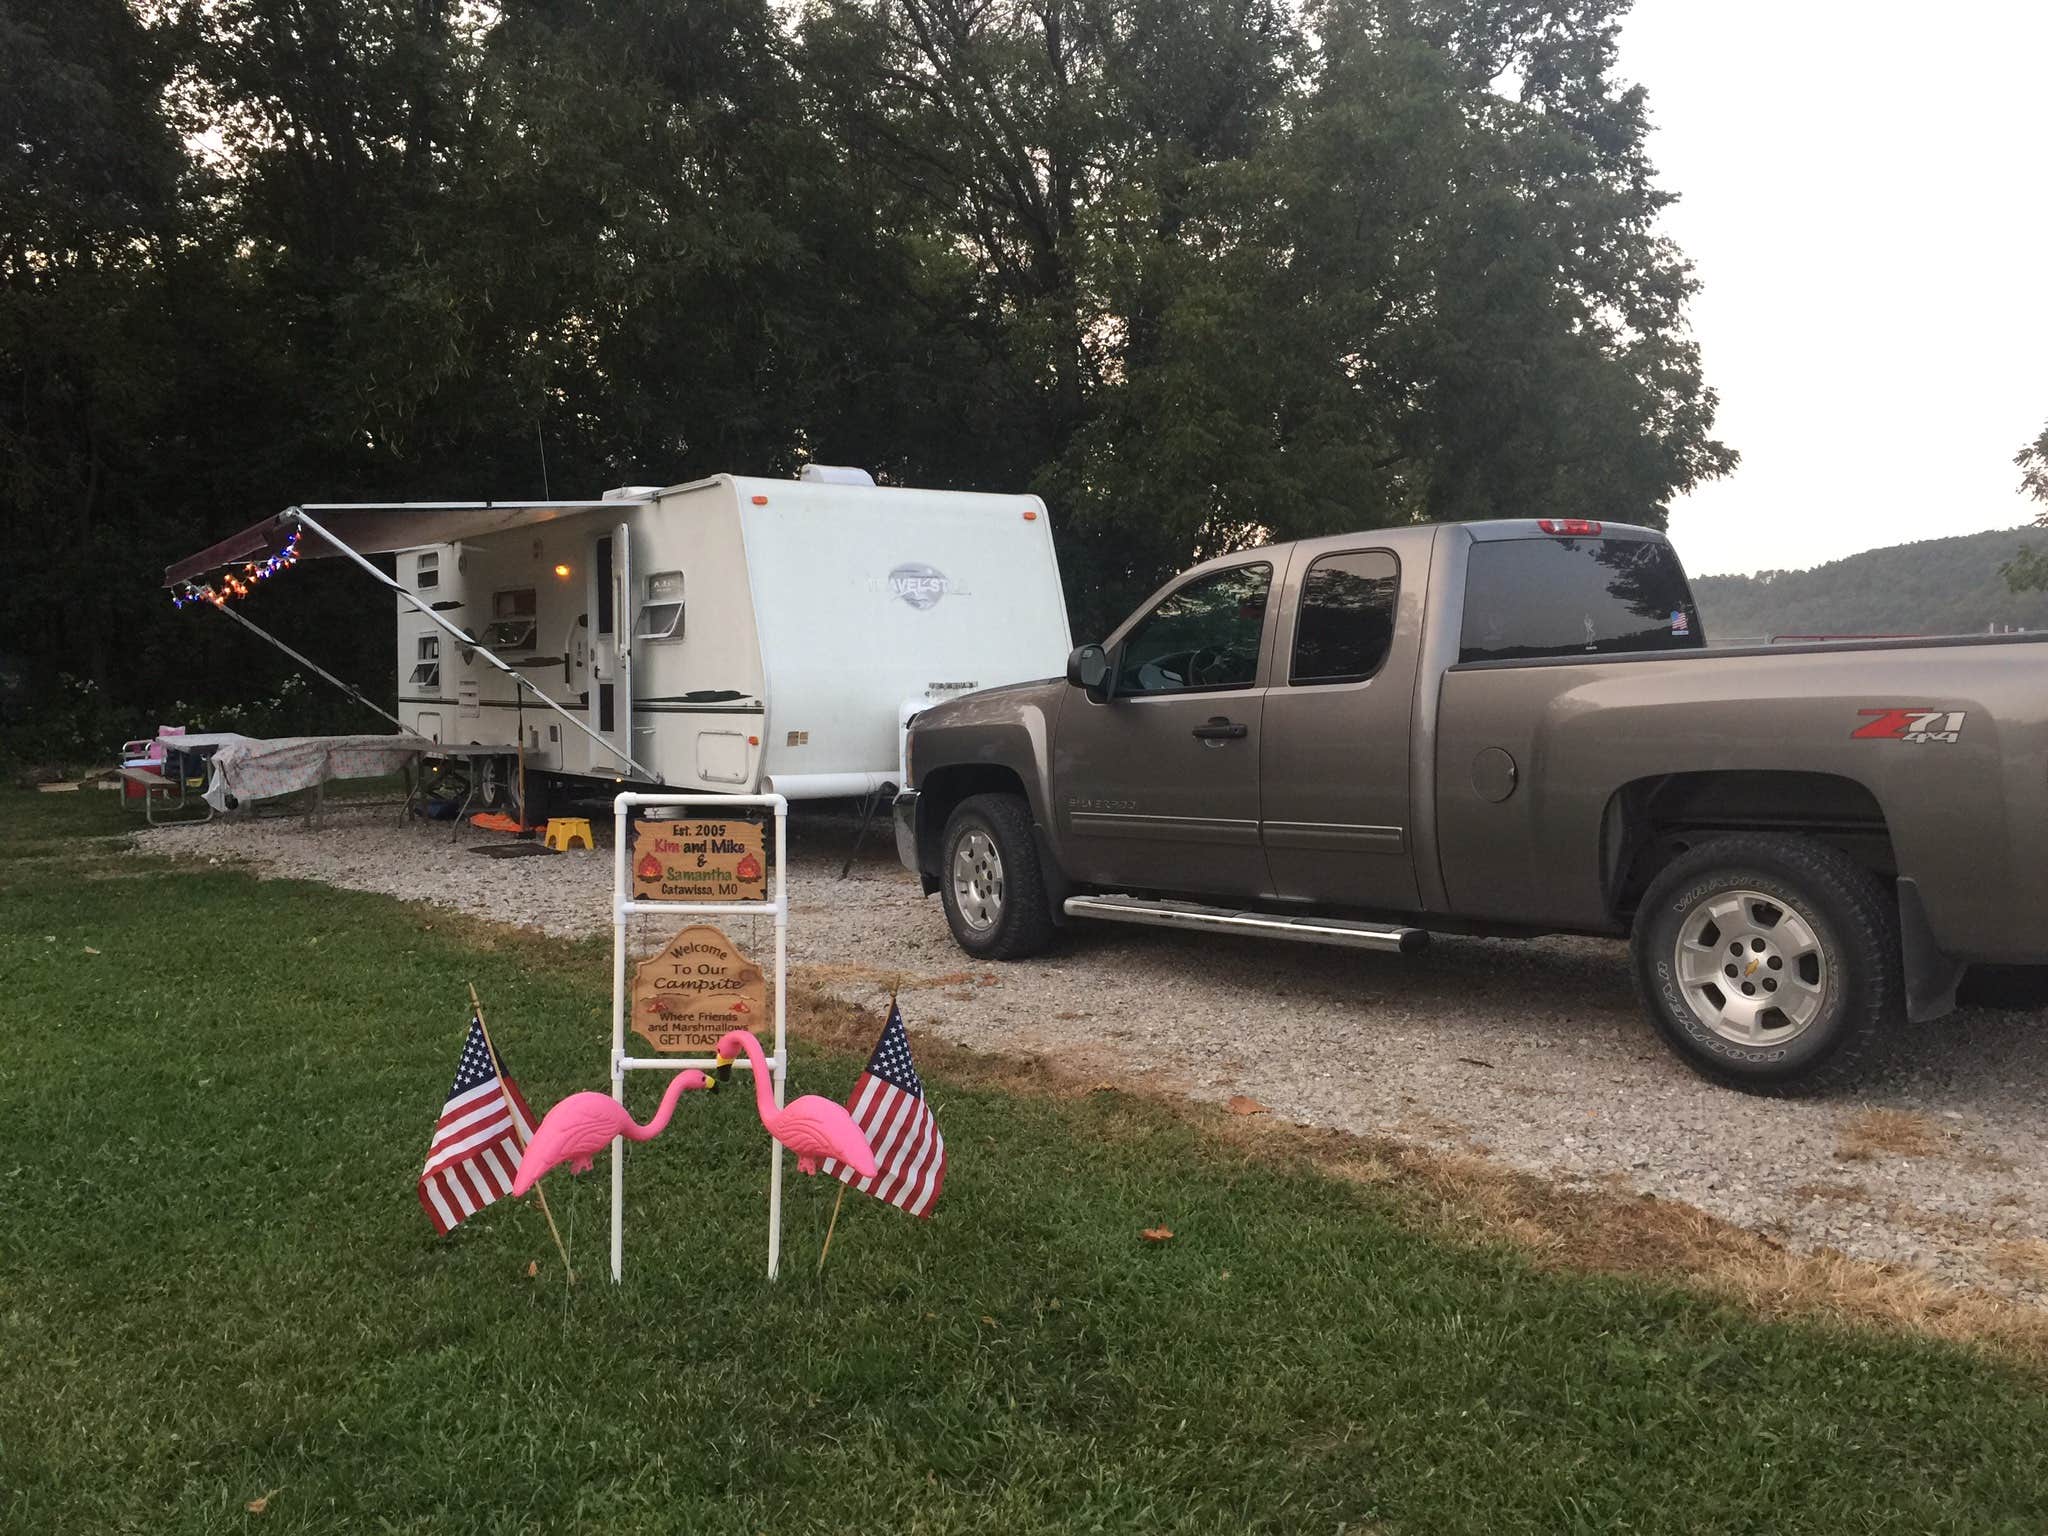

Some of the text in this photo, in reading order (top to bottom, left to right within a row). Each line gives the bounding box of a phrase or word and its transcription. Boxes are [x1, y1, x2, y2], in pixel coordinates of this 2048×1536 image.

[672, 824, 727, 837] Est. 2005
[654, 839, 745, 854] Kim and Mike
[696, 854, 707, 868] &
[666, 867, 732, 882] Samantha
[661, 883, 738, 896] Catawissa, MO
[670, 942, 728, 961] Welcome
[672, 964, 729, 975] To Our
[654, 977, 745, 993] Campsite
[660, 1012, 738, 1022] Where Friends
[647, 1023, 749, 1032] and Marshmallows
[659, 1033, 725, 1045] GET TOAST
